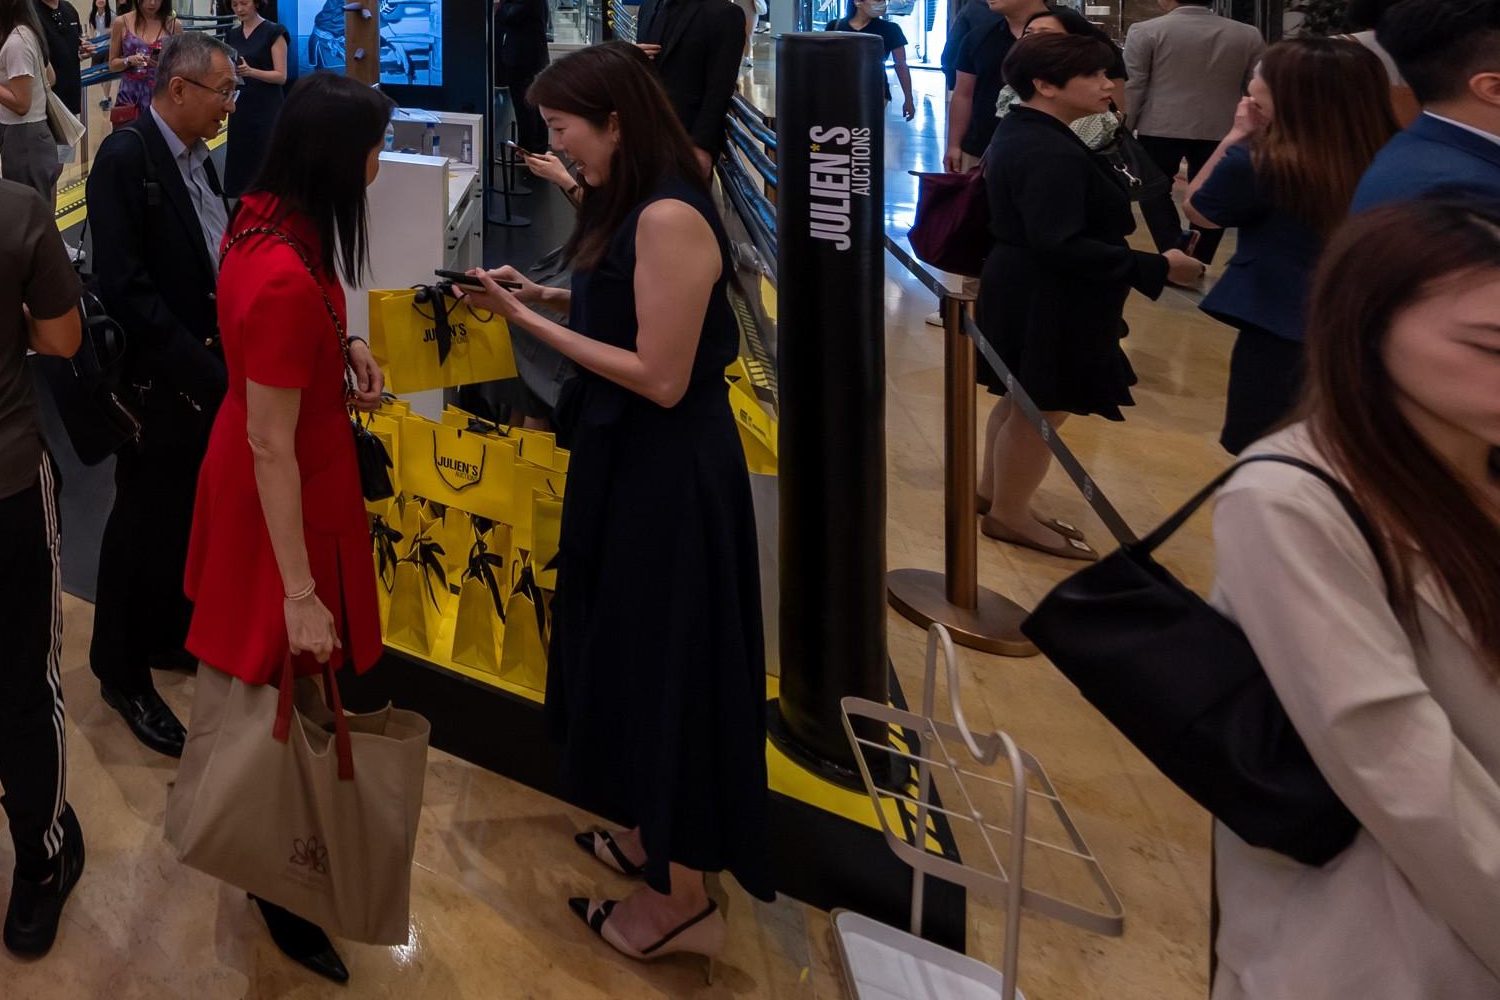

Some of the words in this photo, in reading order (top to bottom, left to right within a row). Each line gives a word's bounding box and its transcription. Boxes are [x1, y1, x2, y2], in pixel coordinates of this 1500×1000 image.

[809, 125, 852, 251] JULIEN'S
[851, 127, 871, 196] AUCTIONS
[437, 456, 479, 476] JULIEN'S
